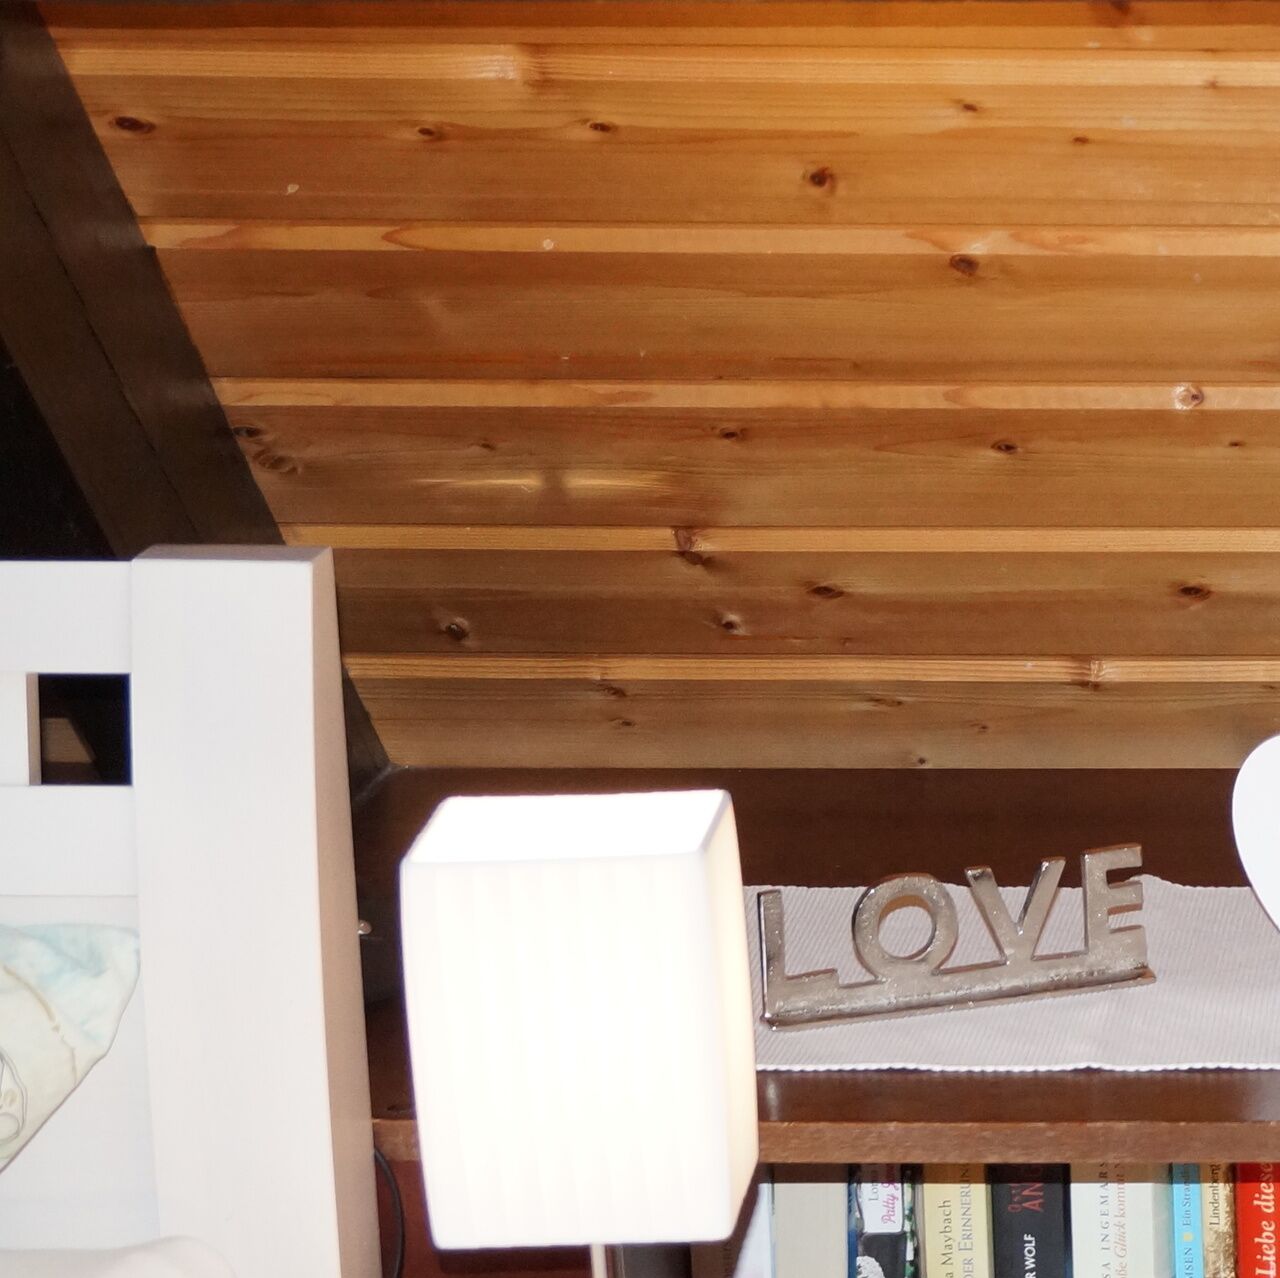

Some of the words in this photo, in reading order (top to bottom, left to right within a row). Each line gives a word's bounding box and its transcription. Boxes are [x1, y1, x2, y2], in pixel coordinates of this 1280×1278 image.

[757, 843, 1148, 1022] LOVE
[939, 1199, 954, 1267] Maybach
[1114, 1220, 1129, 1259] Glück
[1182, 1209, 1192, 1227] Ein
[1023, 1233, 1037, 1269] WOLF
[1254, 1219, 1276, 1277] Liebe
